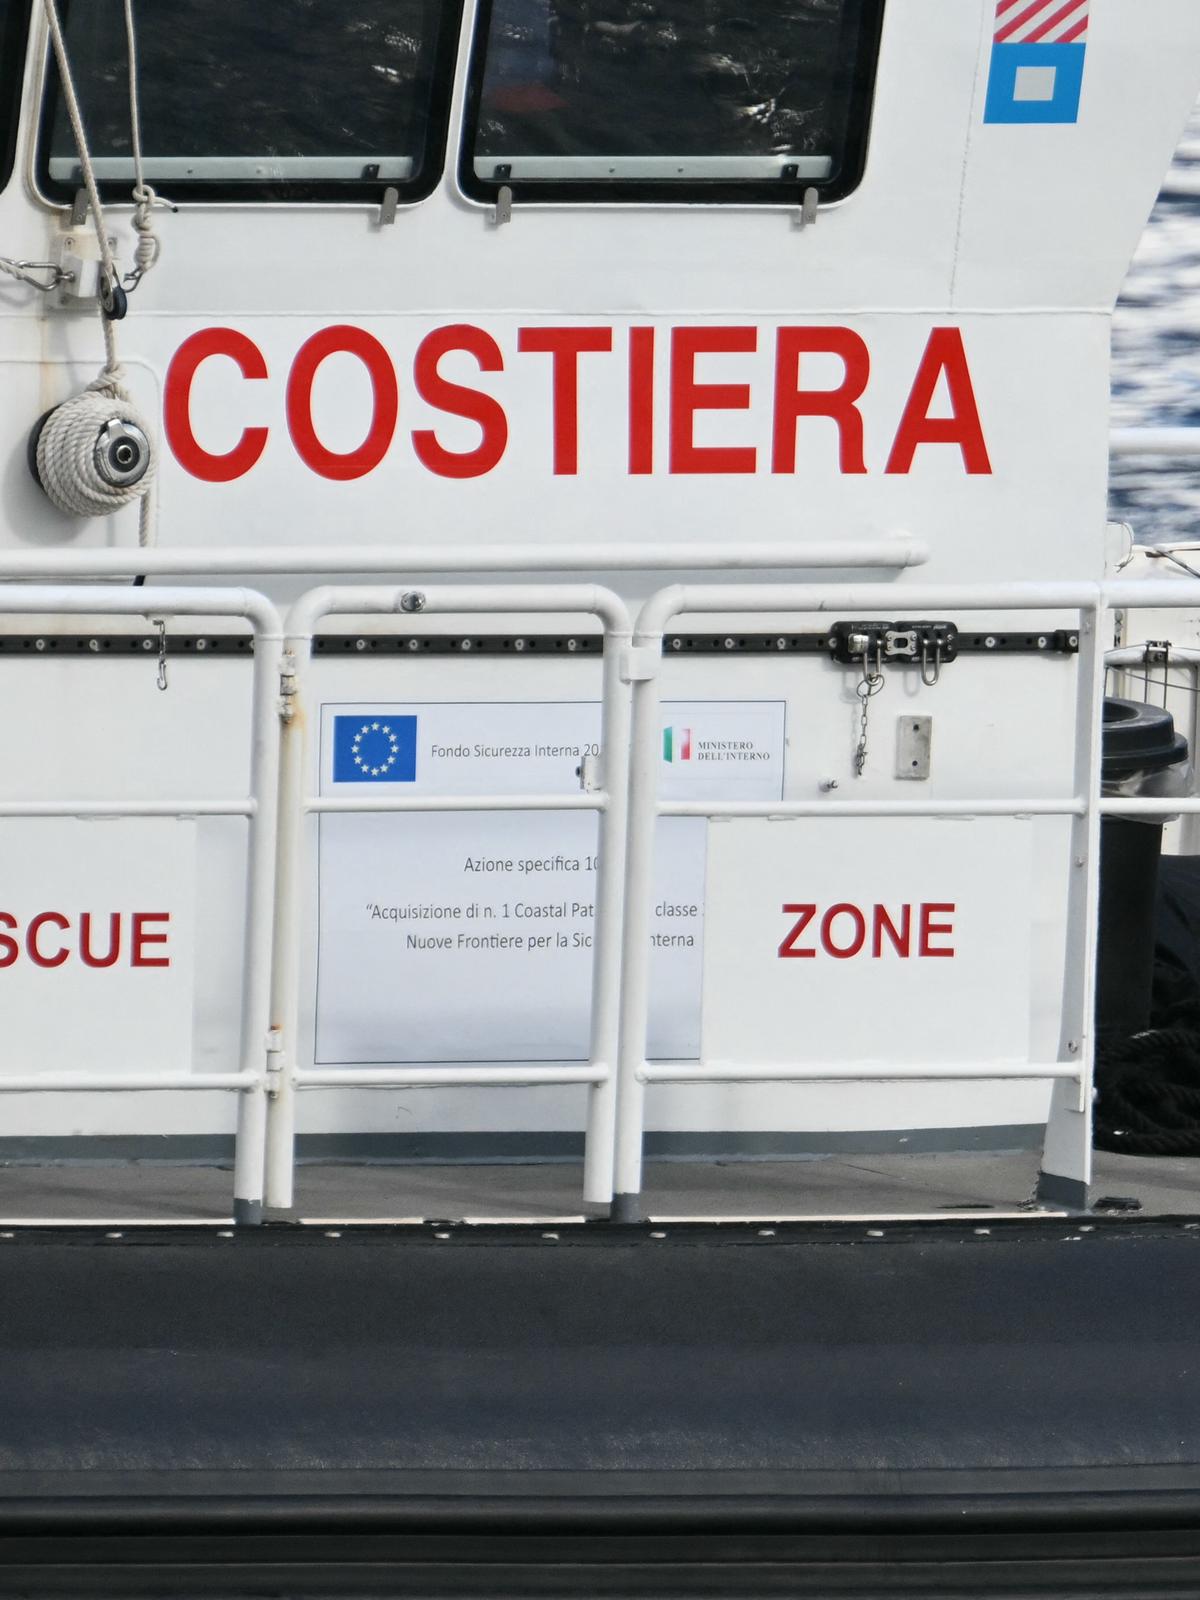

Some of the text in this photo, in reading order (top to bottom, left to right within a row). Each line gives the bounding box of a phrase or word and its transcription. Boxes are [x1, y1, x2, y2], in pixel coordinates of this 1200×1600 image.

[163, 325, 993, 482] COSTIERA
[431, 743, 600, 758] Fondo Sicurezza Interna 20
[697, 741, 753, 750] MINISTERO
[697, 751, 770, 760] DELL'INTERNO
[463, 857, 513, 872] Azione
[517, 856, 580, 875] specifica
[465, 903, 479, 919] di
[483, 907, 497, 919] n.
[501, 904, 510, 918] 1
[514, 902, 566, 918] Coastal
[655, 901, 698, 917] classe
[778, 903, 955, 959] ZONE
[406, 934, 452, 949] Nuove
[457, 933, 523, 949] Frontiere
[527, 935, 552, 951] per
[556, 933, 568, 948] la
[650, 933, 694, 947] nterna
